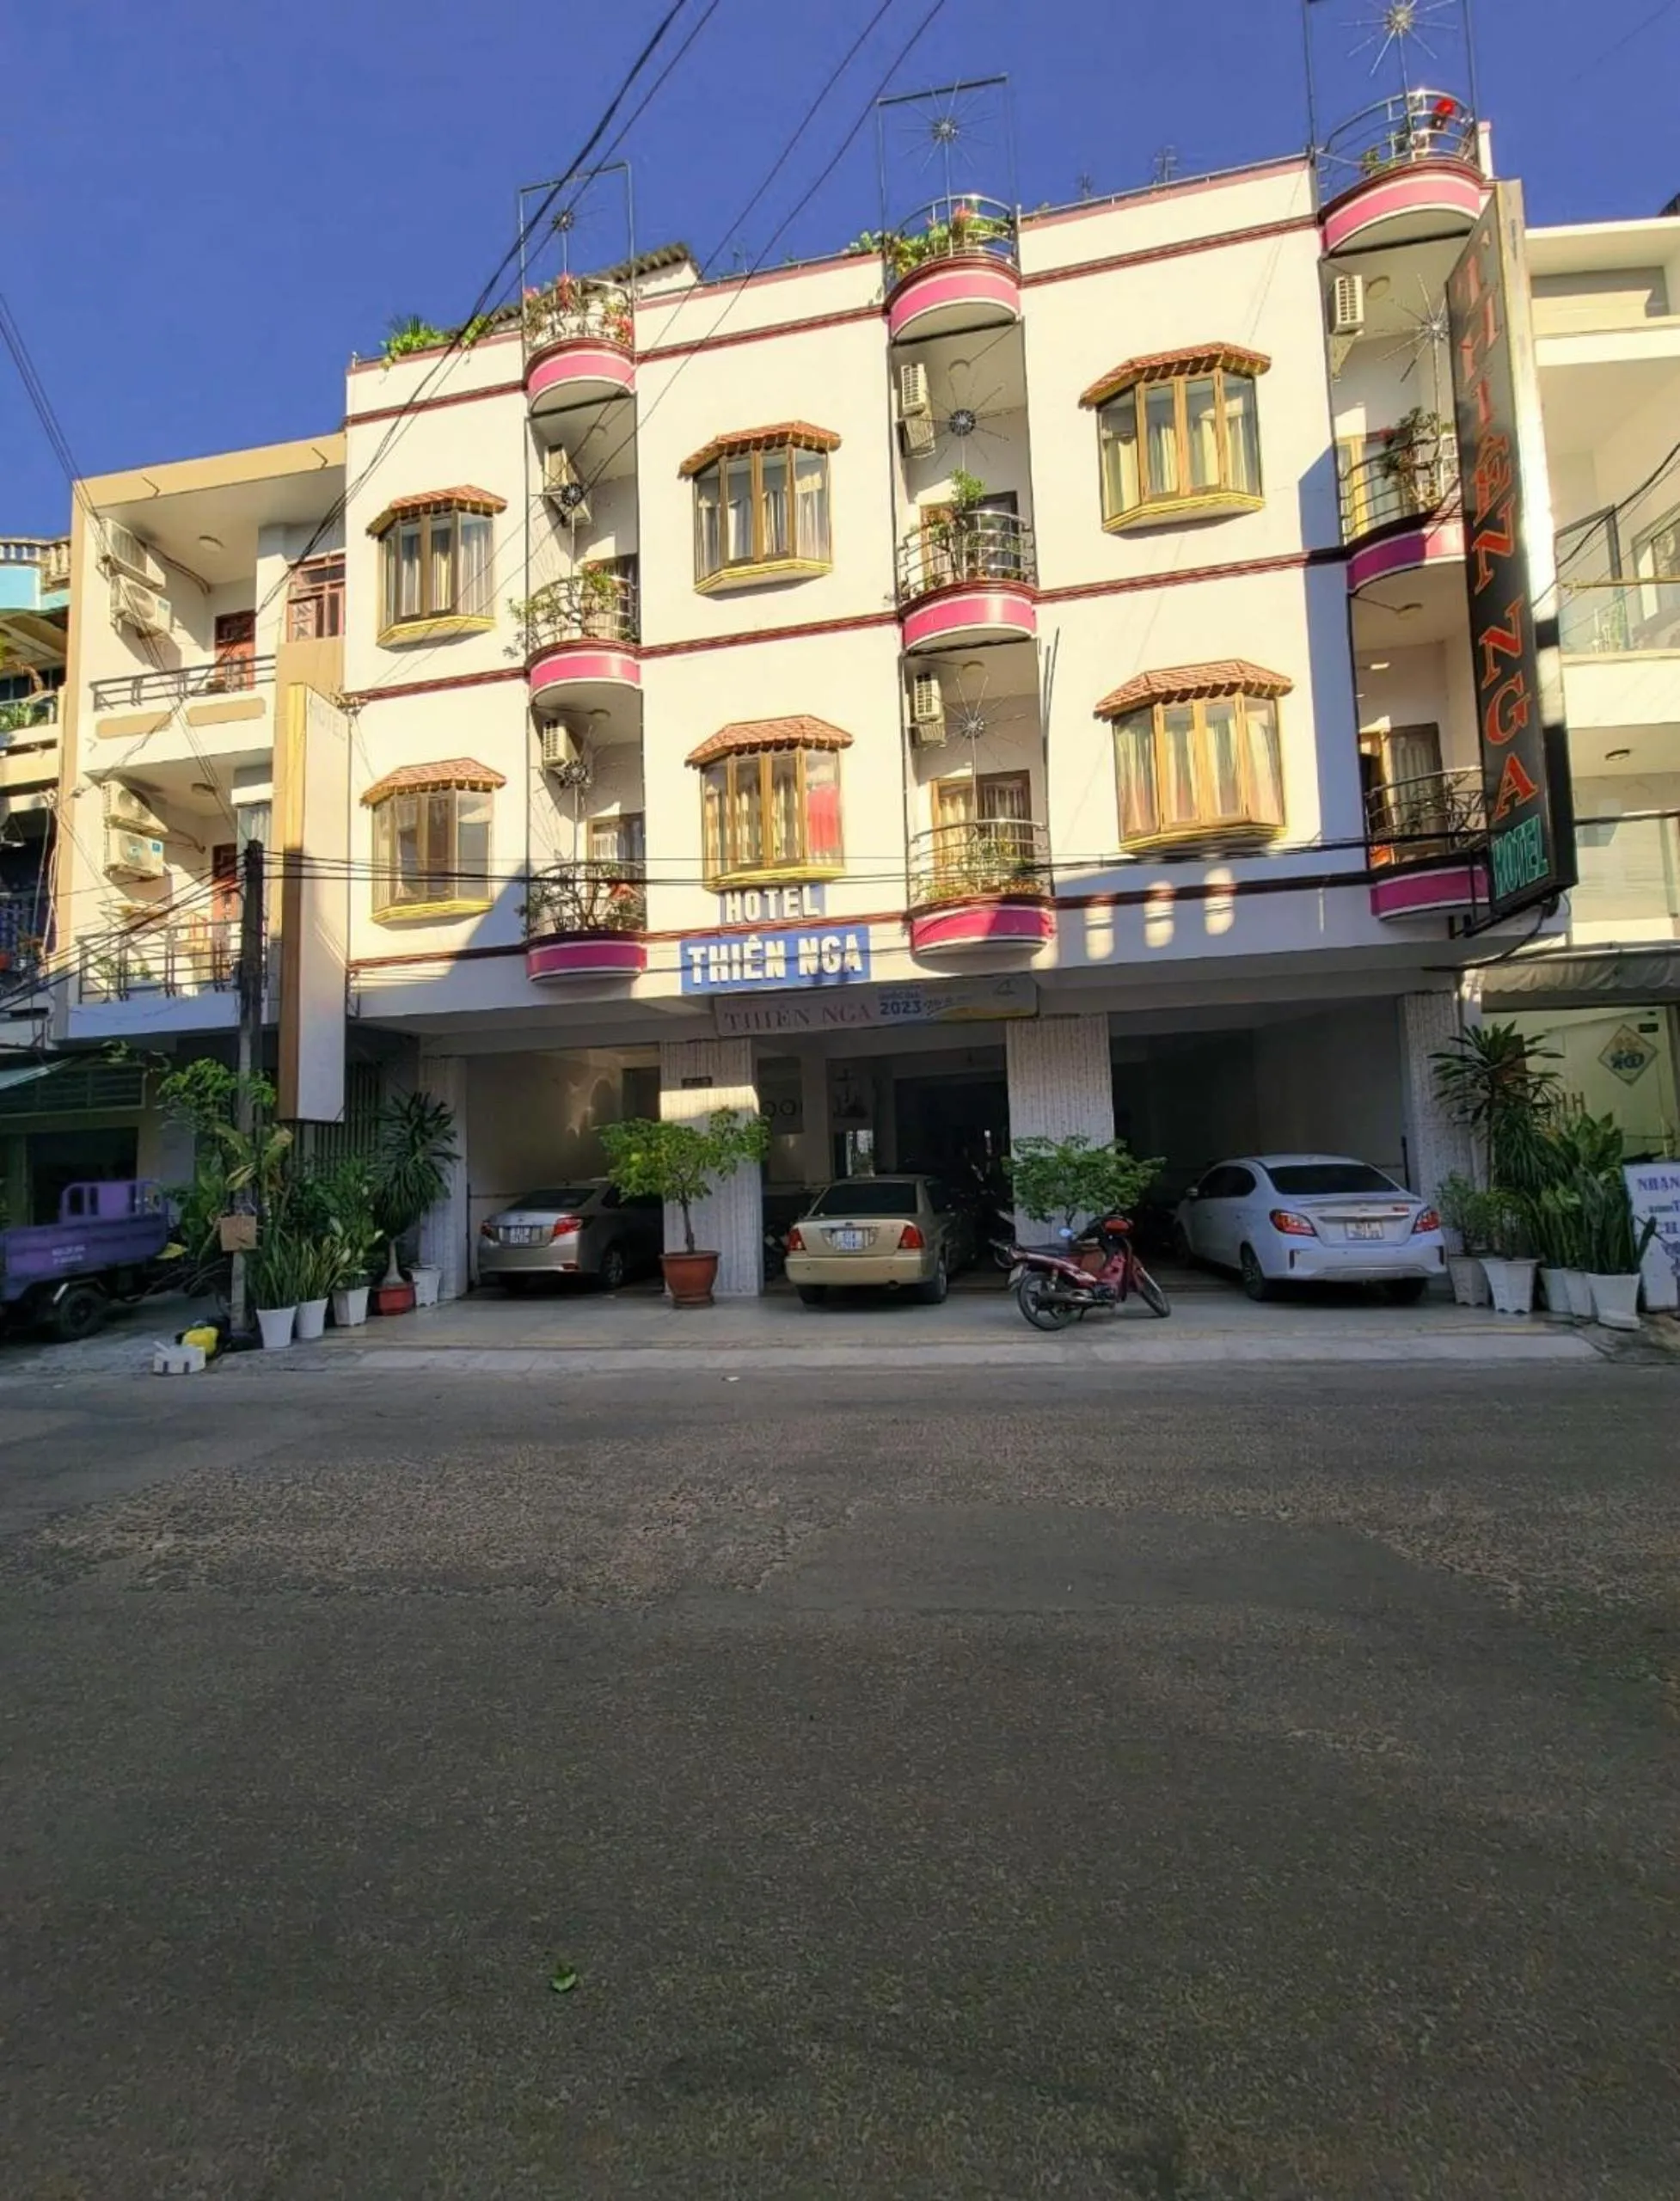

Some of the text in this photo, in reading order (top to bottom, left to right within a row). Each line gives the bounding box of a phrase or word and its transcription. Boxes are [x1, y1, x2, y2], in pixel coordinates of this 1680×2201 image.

[1478, 593, 1539, 822] NGA
[1491, 813, 1549, 901] HOTEL
[725, 884, 820, 924] HOTEL
[688, 934, 862, 984] THIÊN NGA
[821, 1003, 873, 1023] NGA
[879, 999, 922, 1016] 2023
